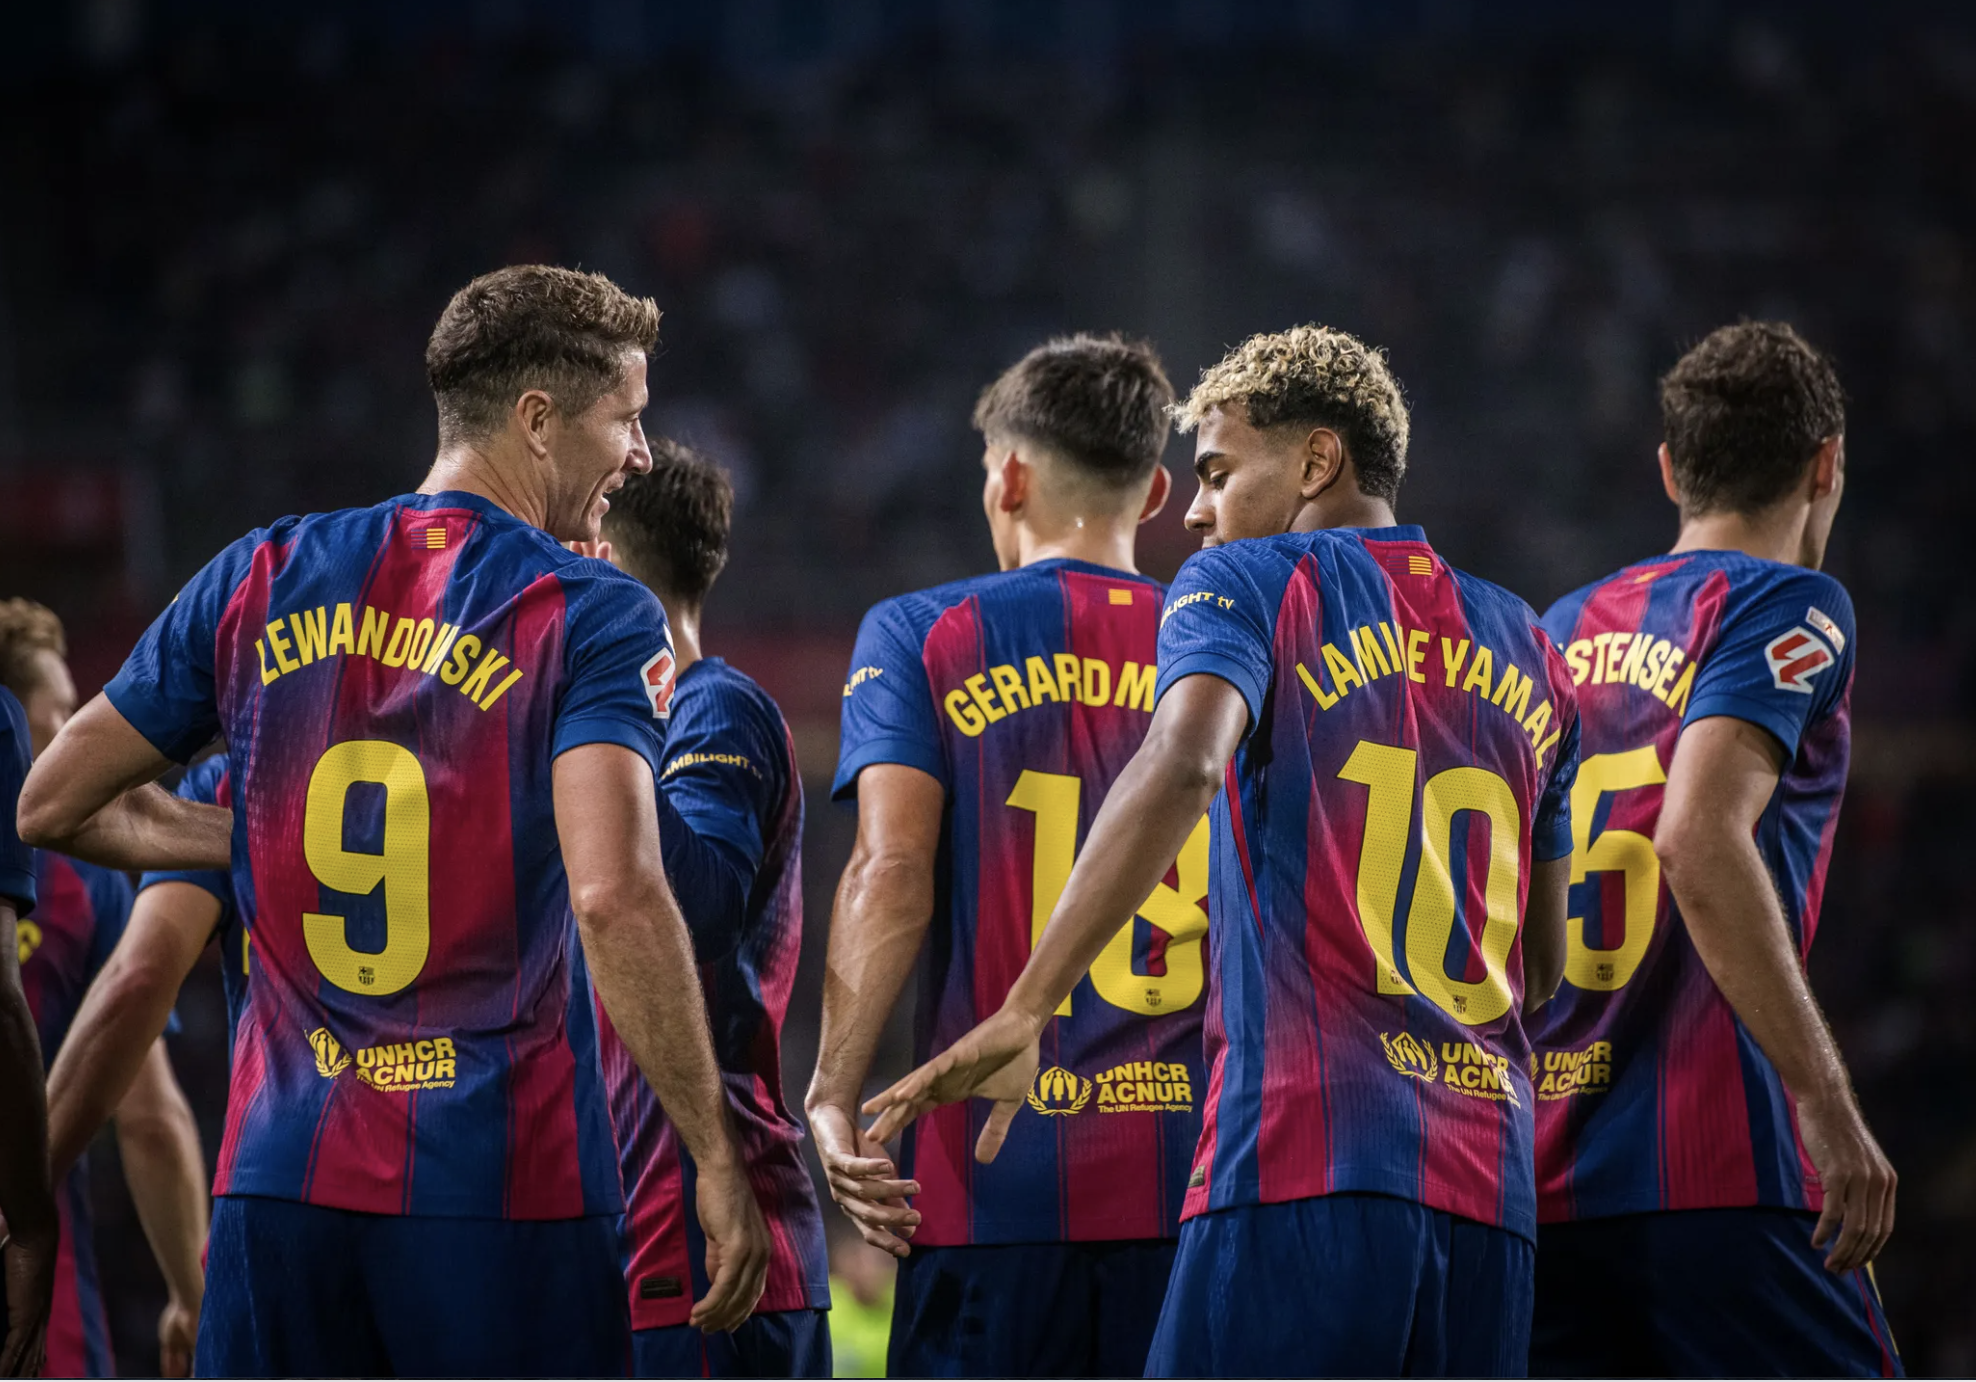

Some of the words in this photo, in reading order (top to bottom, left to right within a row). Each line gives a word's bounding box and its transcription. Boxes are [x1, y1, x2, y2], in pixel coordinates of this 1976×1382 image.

[1556, 632, 1697, 718] STENSEN
[944, 653, 1112, 738] GERARD
[1441, 636, 1561, 770] YAMAL
[302, 740, 430, 997] 9
[1336, 739, 1522, 1026] 10
[1005, 769, 1210, 1017] 18
[356, 1037, 457, 1069] UNHCR
[356, 1058, 457, 1086] ACNUR
[384, 1083, 422, 1093] Refugee
[421, 1080, 456, 1090] Agency
[1095, 1061, 1191, 1084] UNHCR
[1096, 1082, 1194, 1105] ACNUR
[1097, 1104, 1115, 1114] The
[1115, 1104, 1129, 1113] UN
[1129, 1103, 1165, 1113] Refugee
[1164, 1103, 1194, 1114] Agency
[1460, 1087, 1474, 1097] UN
[1473, 1089, 1507, 1101] Refugee
